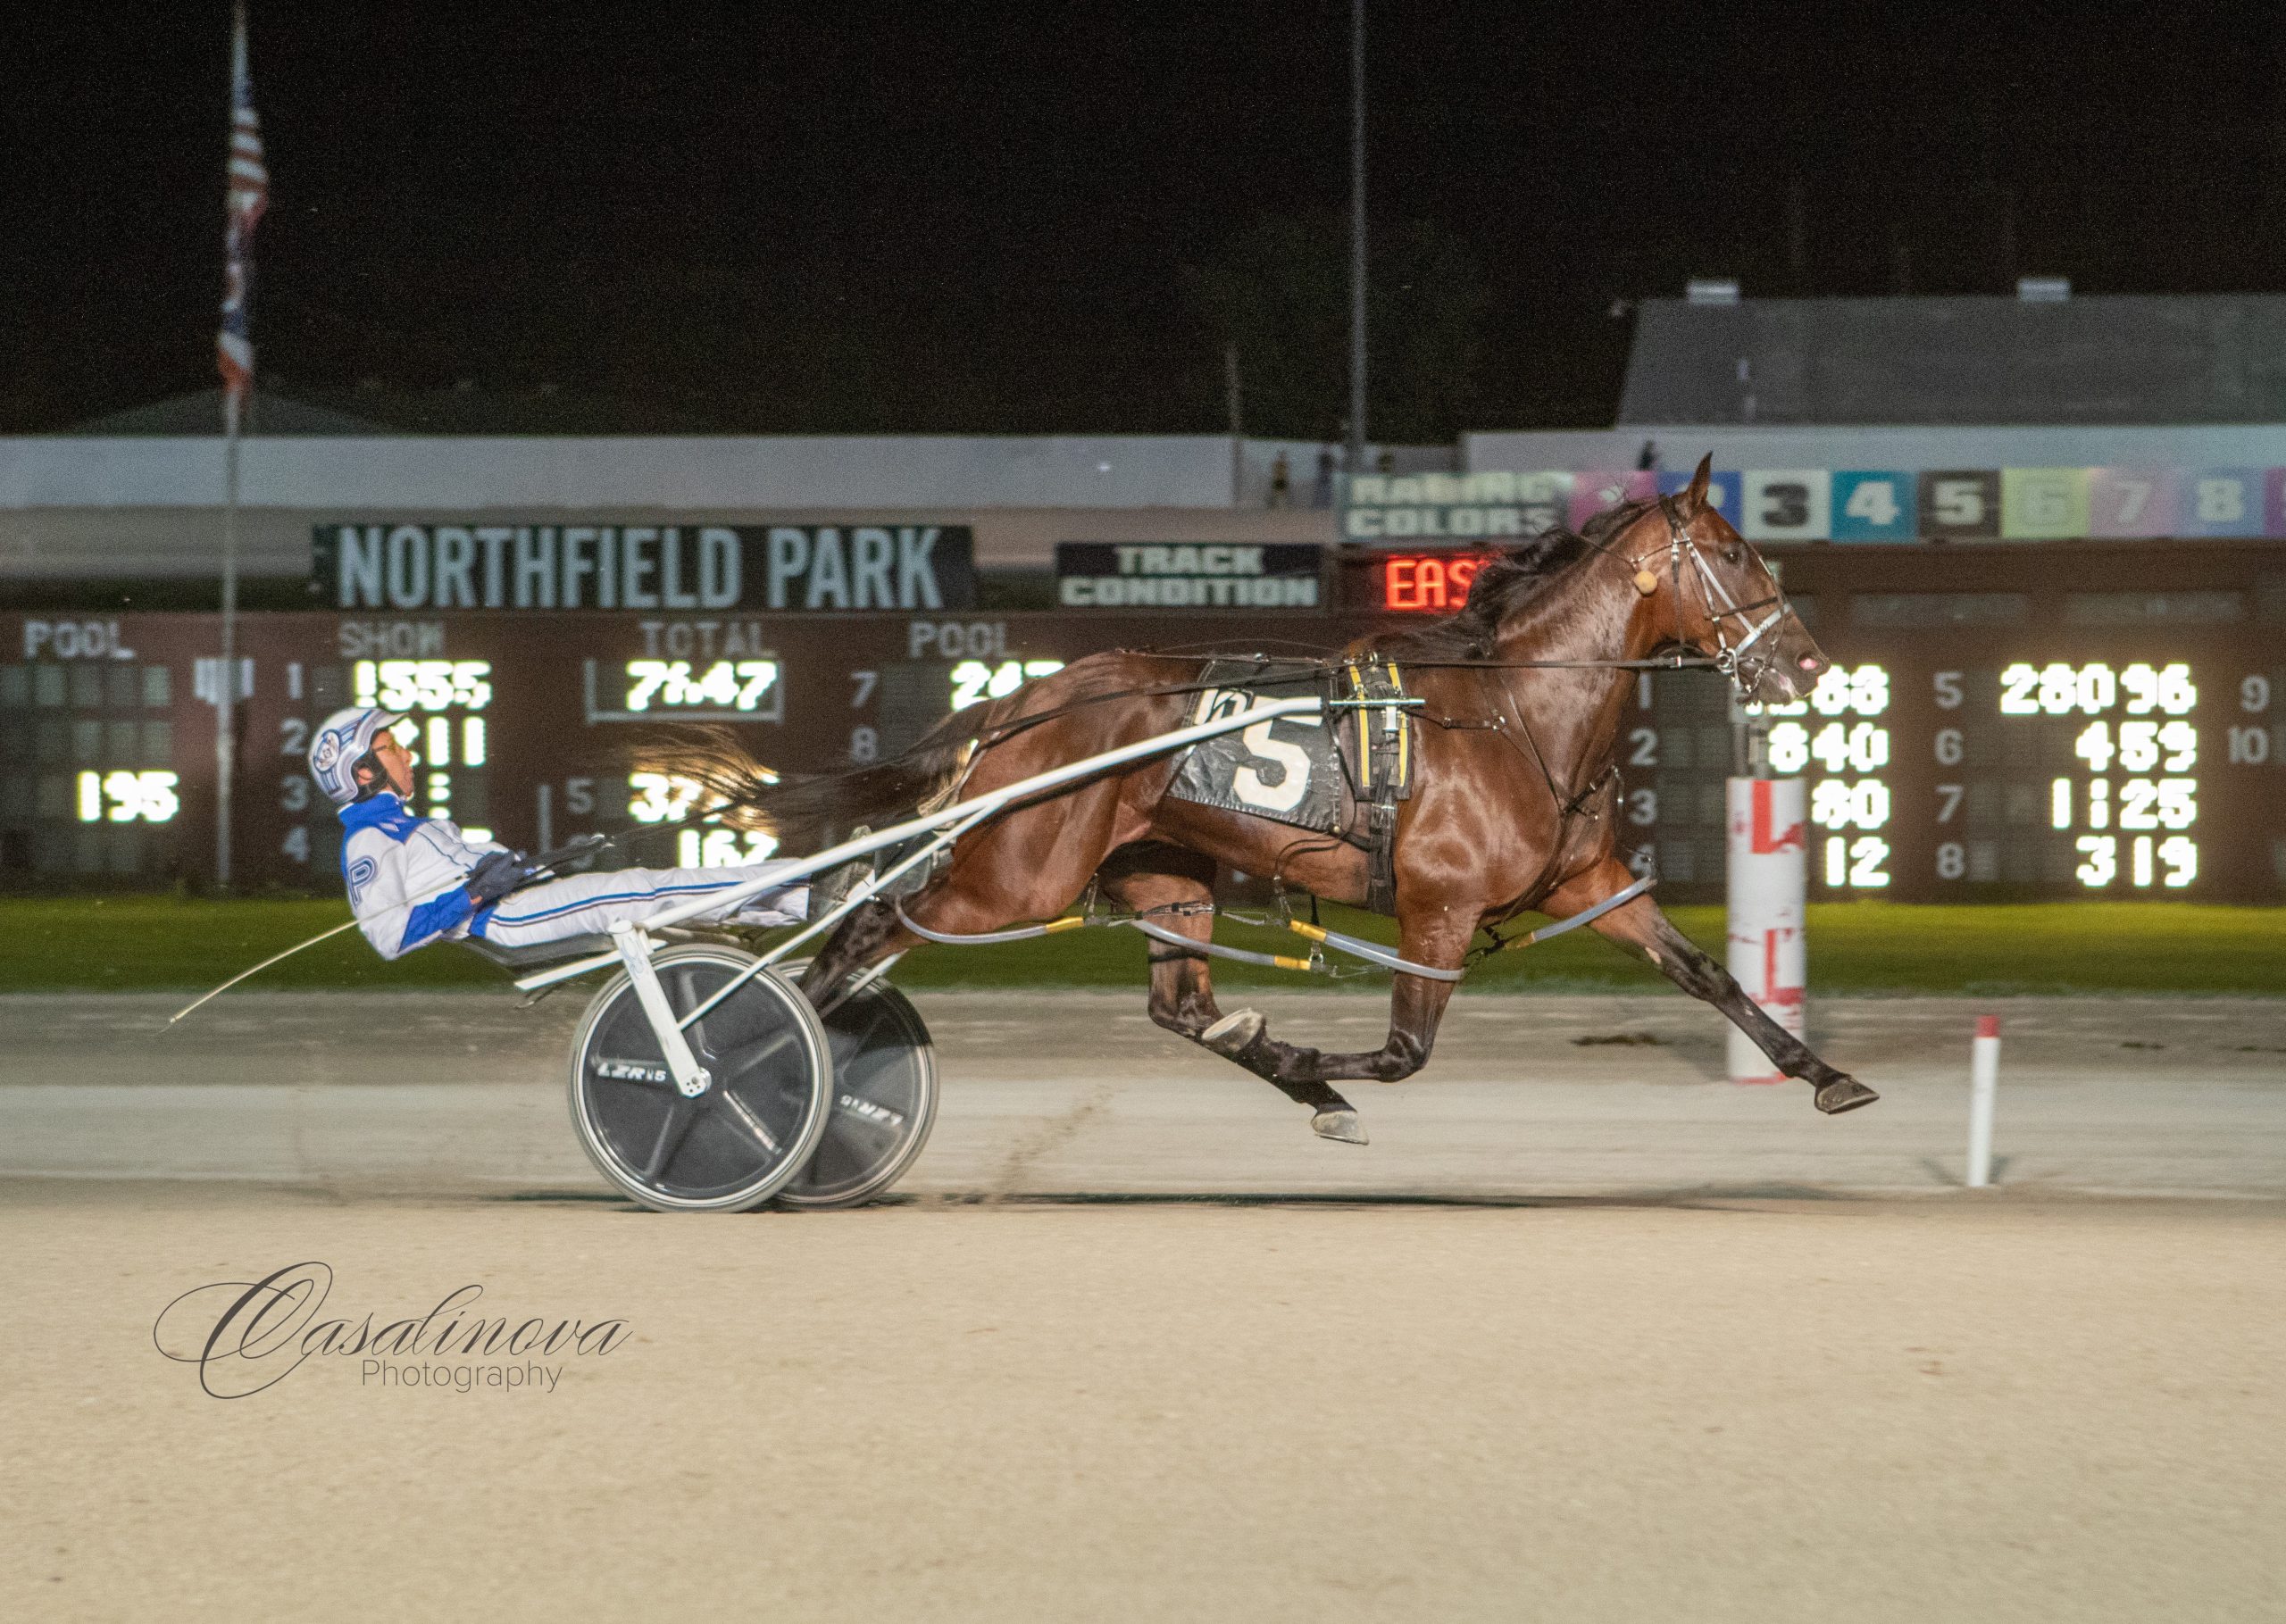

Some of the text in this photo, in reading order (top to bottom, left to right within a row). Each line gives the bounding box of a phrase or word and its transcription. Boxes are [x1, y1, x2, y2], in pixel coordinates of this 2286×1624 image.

[1763, 483, 1810, 528] 3
[1846, 481, 1899, 525] 4
[1934, 480, 1982, 525] 5
[2112, 481, 2151, 524] 7
[2197, 479, 2243, 521] 8
[1347, 507, 1558, 536] COLORS
[338, 525, 943, 610] NORTHFIELD PARK
[1115, 546, 1264, 574] TRACK
[1061, 578, 1317, 606] CONDITION
[1386, 560, 1482, 611] EAS
[23, 620, 135, 660] POOL
[340, 621, 446, 659] SHOW
[640, 622, 776, 657] TOTAL
[909, 622, 1022, 658] POOL
[287, 662, 303, 699] 1
[850, 670, 879, 707] 7
[1637, 671, 1651, 709] 1
[1933, 670, 1963, 709] 5
[2241, 675, 2270, 712] 9
[280, 717, 307, 754] 2
[850, 727, 878, 762] 8
[1233, 695, 1323, 812] 5
[1630, 728, 1657, 766] 2
[1934, 729, 1963, 765] 6
[2074, 720, 2198, 772] 459
[2228, 726, 2269, 764] 10
[281, 774, 308, 812] 3
[566, 778, 594, 815] 5
[1629, 789, 1657, 826] 3
[1936, 784, 1964, 823] 7
[282, 826, 309, 862] 4
[1825, 837, 1890, 887] 12
[1936, 842, 1965, 879] 8
[2075, 836, 2198, 887] 319
